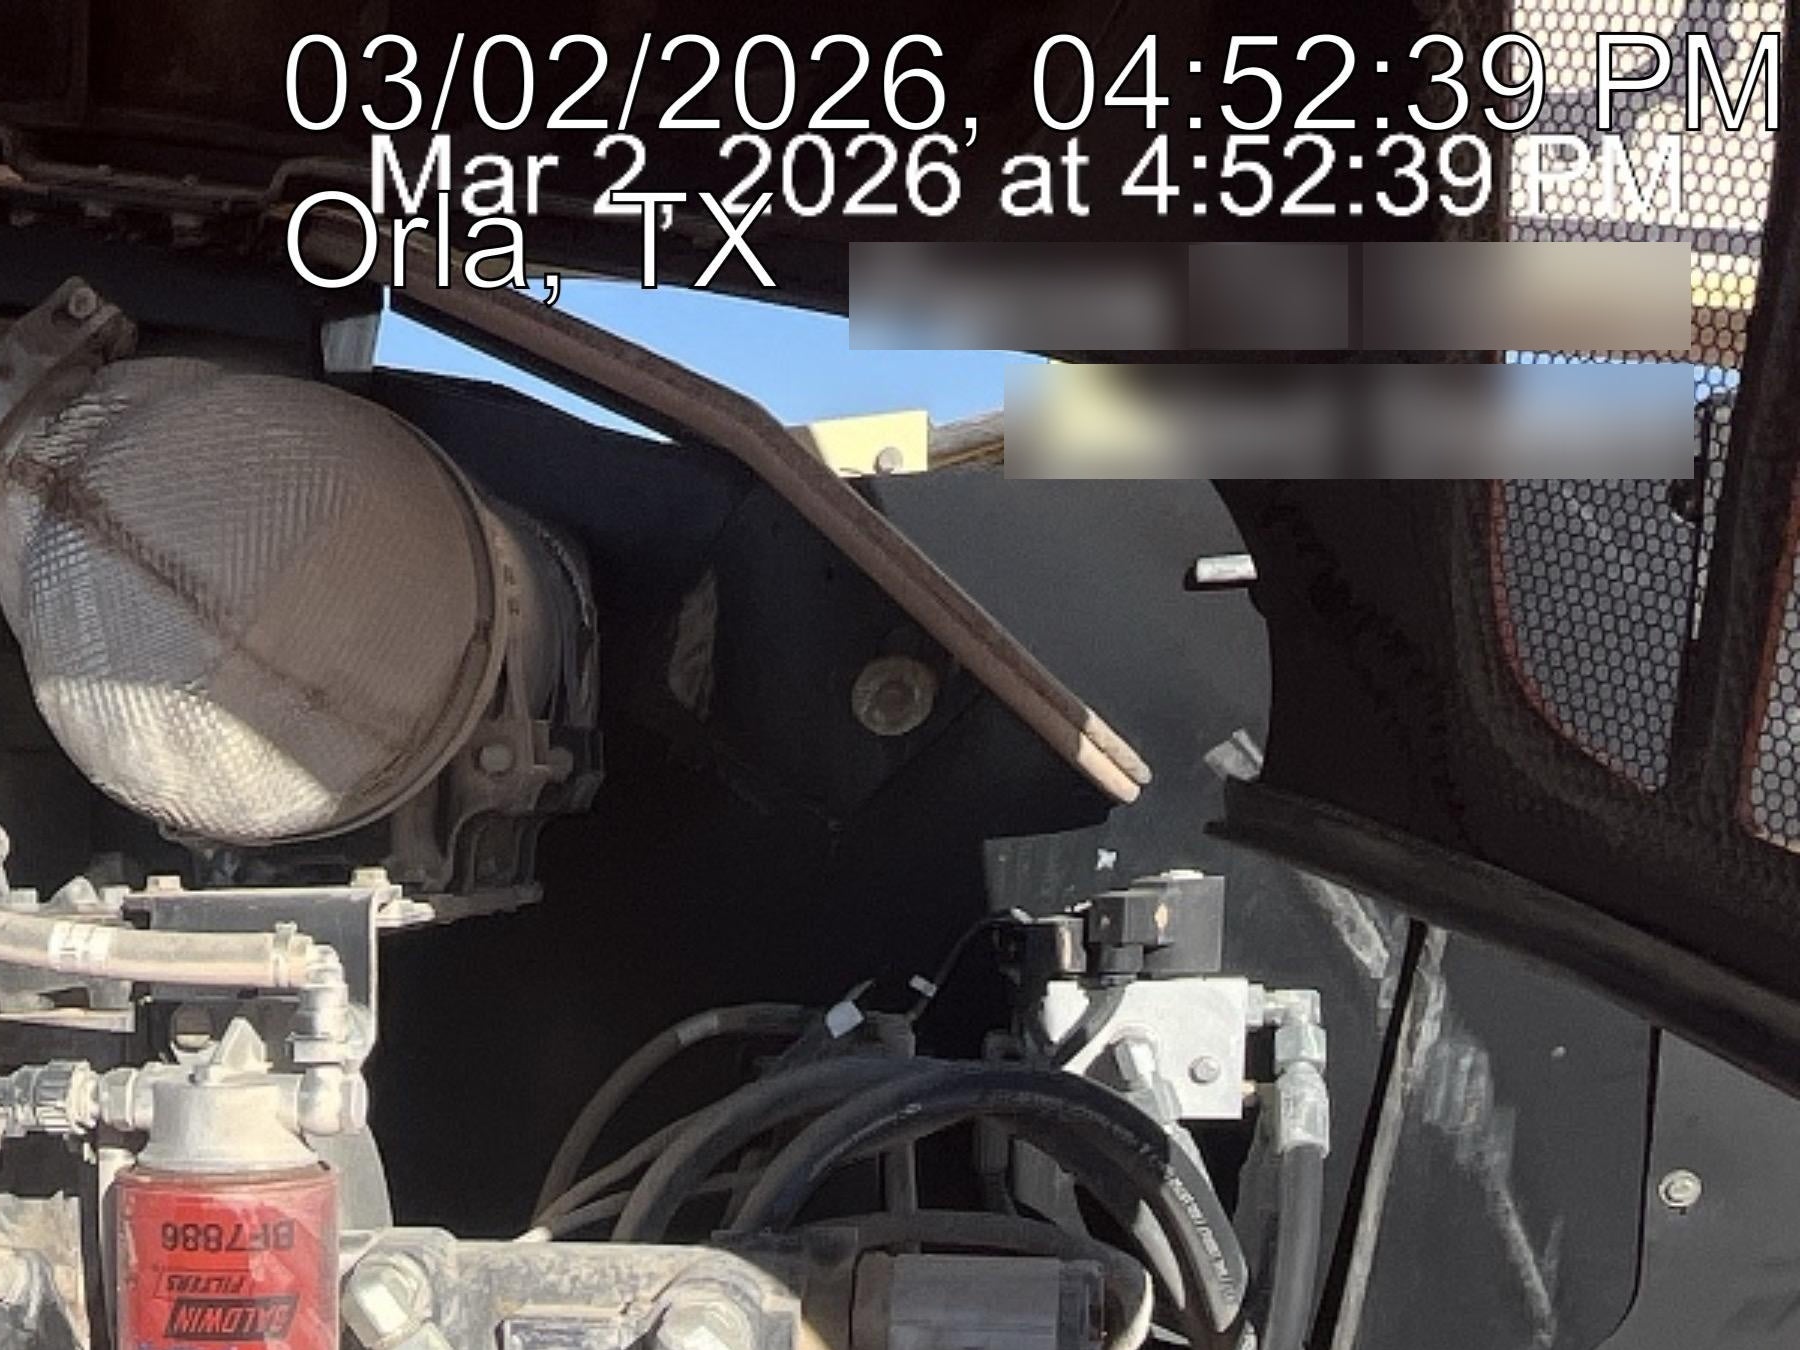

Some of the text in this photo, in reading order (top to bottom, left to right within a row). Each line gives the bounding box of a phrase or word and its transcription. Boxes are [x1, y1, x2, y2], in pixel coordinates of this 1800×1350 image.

[161, 1221, 295, 1251] BF7886
[167, 1273, 246, 1293] FILTERS
[171, 1302, 291, 1334] BALDWIN
